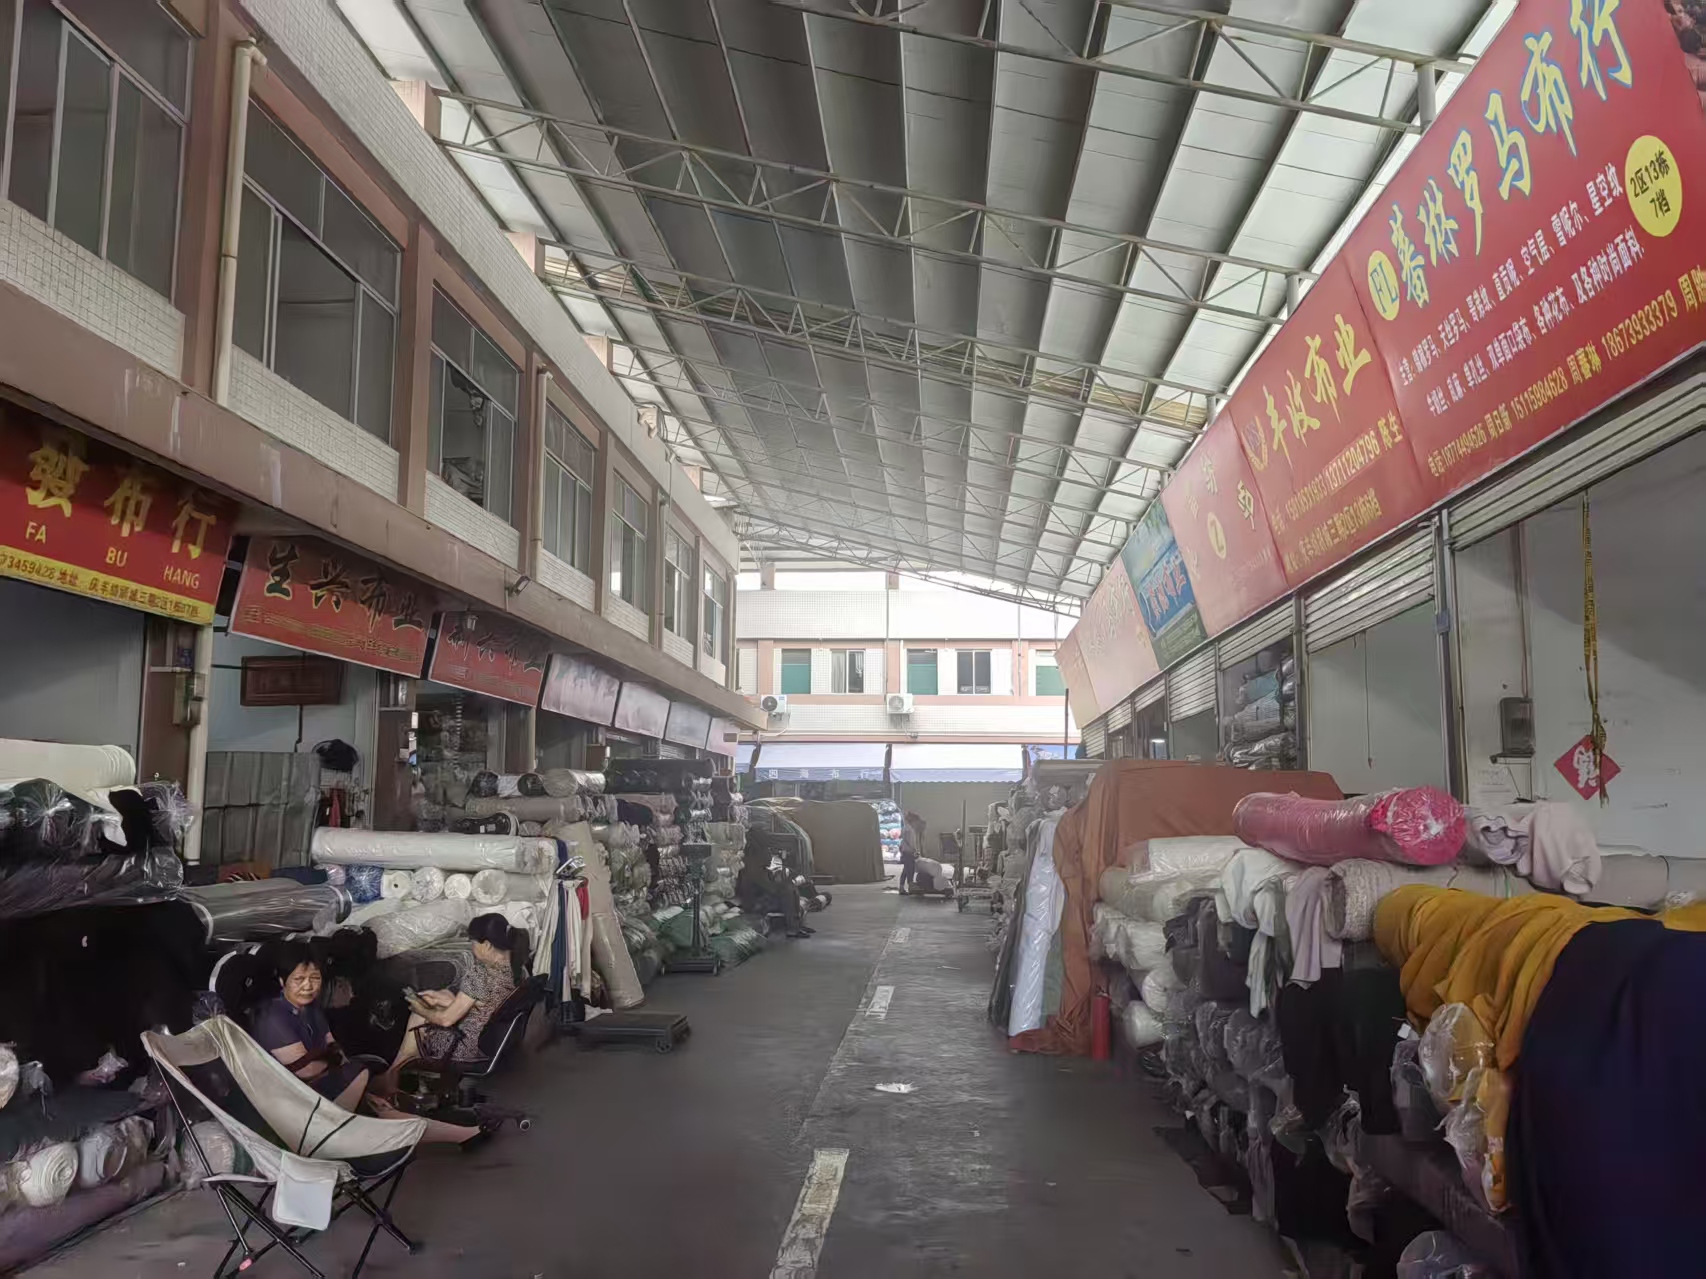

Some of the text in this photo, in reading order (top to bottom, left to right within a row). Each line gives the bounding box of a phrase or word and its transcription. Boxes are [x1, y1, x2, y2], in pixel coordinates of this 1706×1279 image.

[1630, 149, 1670, 198] 2区13栋
[1649, 188, 1671, 218] 7档
[1602, 290, 1677, 360] 18673933379
[26, 521, 200, 590] FA BU HANG
